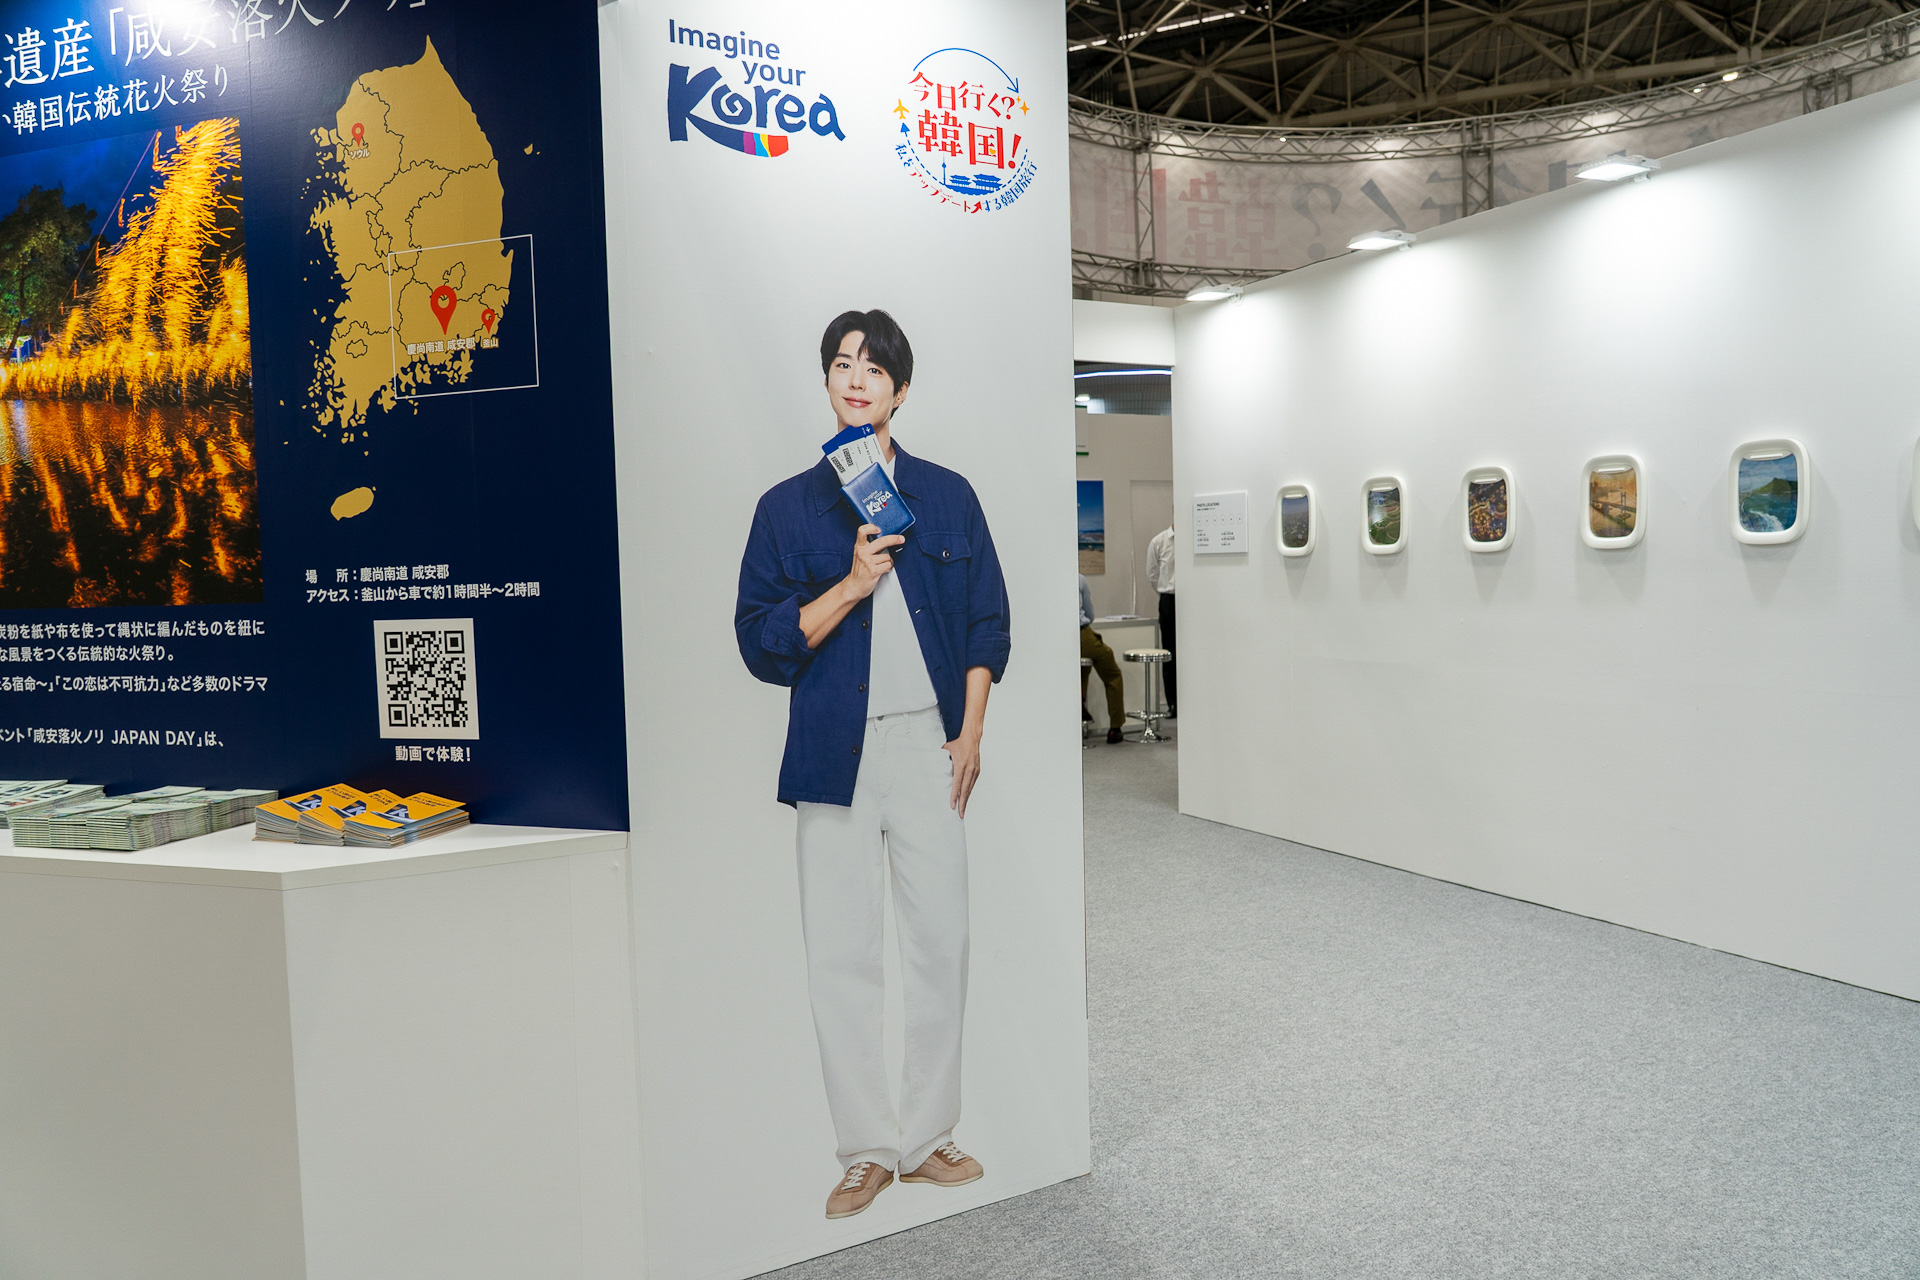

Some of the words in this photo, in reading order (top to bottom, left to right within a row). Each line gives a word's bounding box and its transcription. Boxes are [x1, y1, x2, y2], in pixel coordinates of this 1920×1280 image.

[669, 18, 780, 61] Imagine
[741, 60, 806, 87] your
[908, 71, 1016, 121] 今日行く?
[667, 63, 846, 157] Korea
[917, 108, 1022, 170] 韓国!
[350, 148, 370, 160] ソウル
[482, 337, 500, 349] 釜山
[865, 491, 893, 517] Korea
[411, 564, 450, 581] 咸安郡
[111, 731, 160, 745] JAPAN
[395, 745, 471, 762] 動画で体験！
